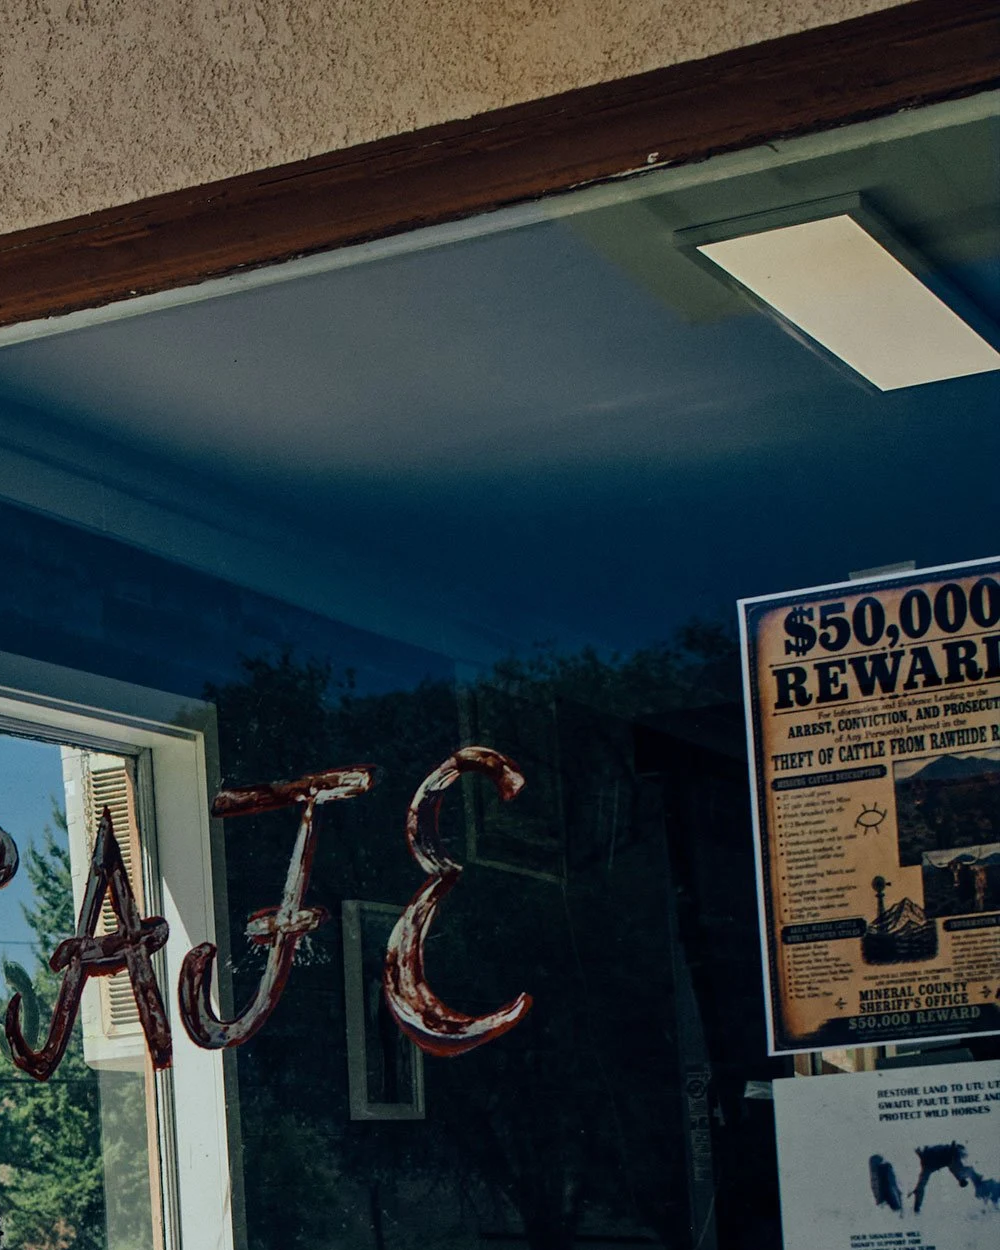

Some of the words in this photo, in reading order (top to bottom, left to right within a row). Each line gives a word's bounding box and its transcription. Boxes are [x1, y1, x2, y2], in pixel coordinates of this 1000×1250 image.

[783, 577, 1000, 657] $50,000
[788, 721, 835, 739] ARREST,
[838, 709, 912, 732] CONVICTION,
[916, 705, 940, 721] AND
[771, 750, 813, 771] THEFT
[818, 747, 835, 765] OF
[838, 740, 885, 763] CATTLE
[889, 734, 925, 756] FROM
[929, 725, 988, 750] RAWHIDE
[858, 985, 914, 1001] MINERAL
[918, 981, 968, 996] COUNTY
[859, 997, 921, 1014] SHERIFF'S
[925, 993, 969, 1008] OFFICE
[916, 1006, 980, 1024] REWARD
[877, 1087, 920, 1099] RESTORE
[923, 1085, 948, 1095] LAND
[951, 1083, 963, 1092] TO
[966, 1082, 984, 1091] UTU
[953, 1093, 981, 1104] TRIBE
[879, 1111, 921, 1122] PROTECT
[924, 1108, 949, 1118] WILD
[951, 1105, 991, 1116] HORSES
